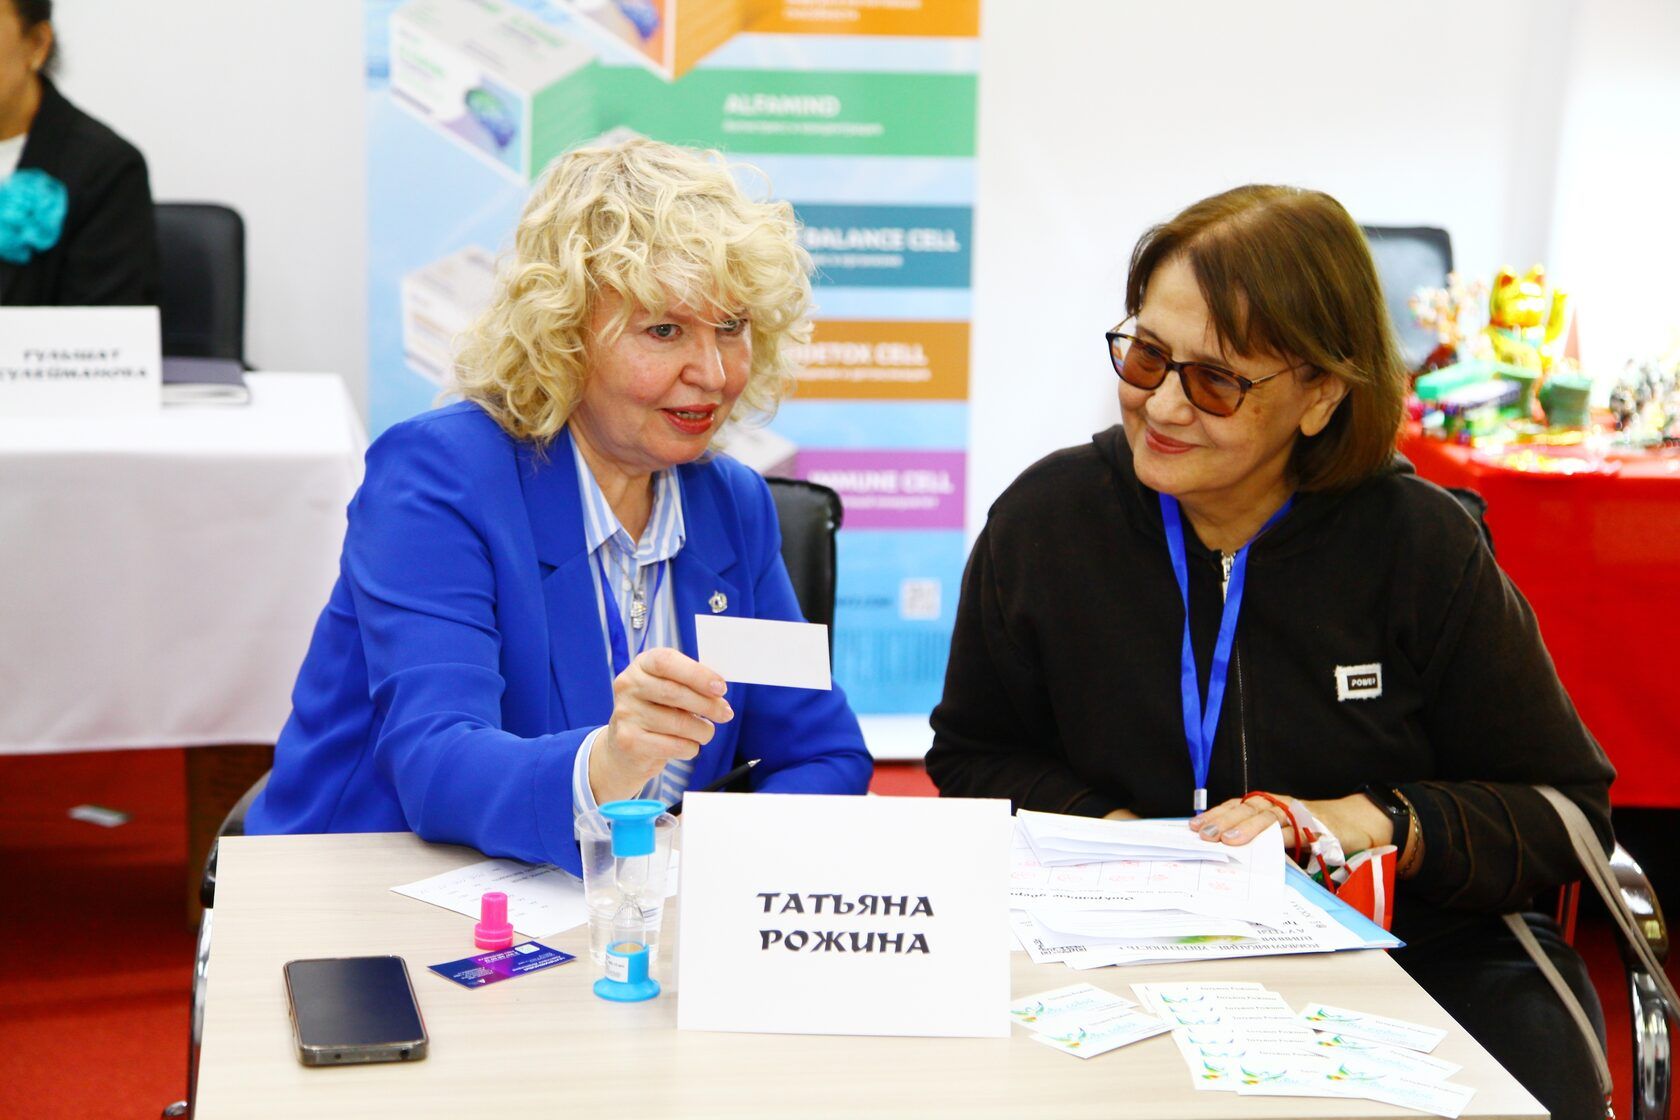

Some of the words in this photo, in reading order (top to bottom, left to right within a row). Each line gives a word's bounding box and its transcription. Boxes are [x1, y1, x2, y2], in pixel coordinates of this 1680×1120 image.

[724, 94, 840, 117] ALFAMIND
[805, 227, 903, 249] BALANCE
[907, 227, 961, 252] CELL
[875, 342, 929, 367] CELL
[901, 471, 955, 494] CELL
[756, 892, 935, 917] ТАТЬЯНА
[758, 929, 931, 954] РОЖИНА
